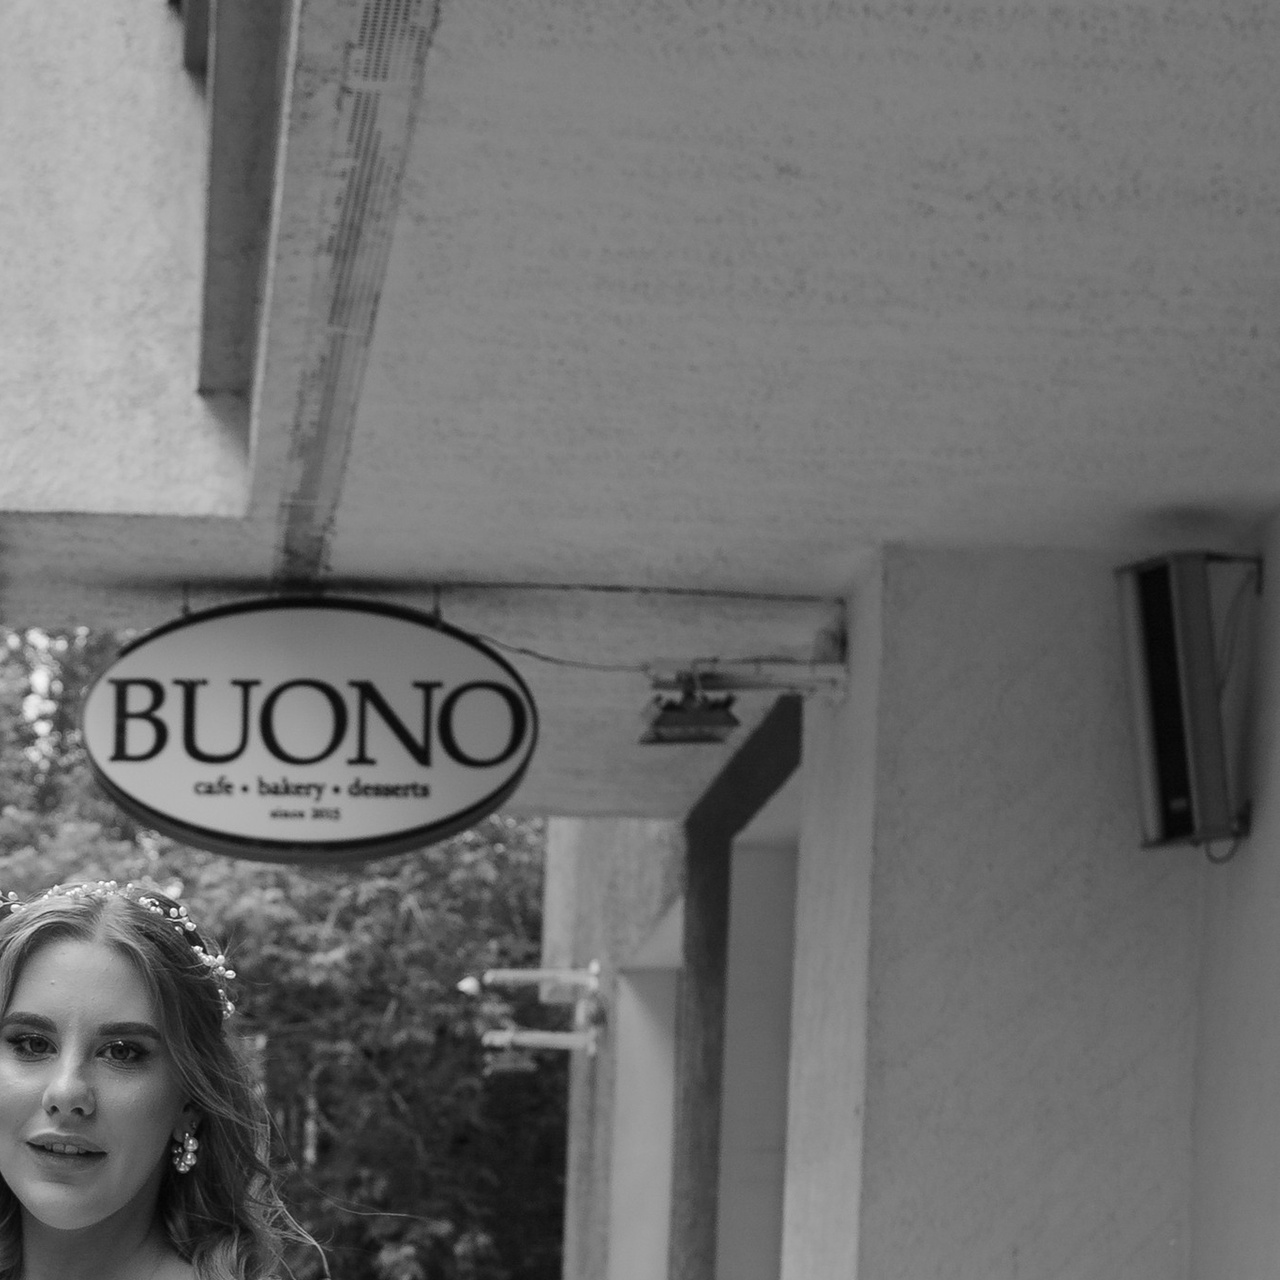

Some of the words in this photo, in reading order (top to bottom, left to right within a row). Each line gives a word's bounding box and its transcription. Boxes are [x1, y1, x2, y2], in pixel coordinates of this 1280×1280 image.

[107, 678, 527, 768] BUONO
[193, 775, 234, 796] cafe
[257, 776, 326, 802] bakery
[347, 777, 431, 798] desserts
